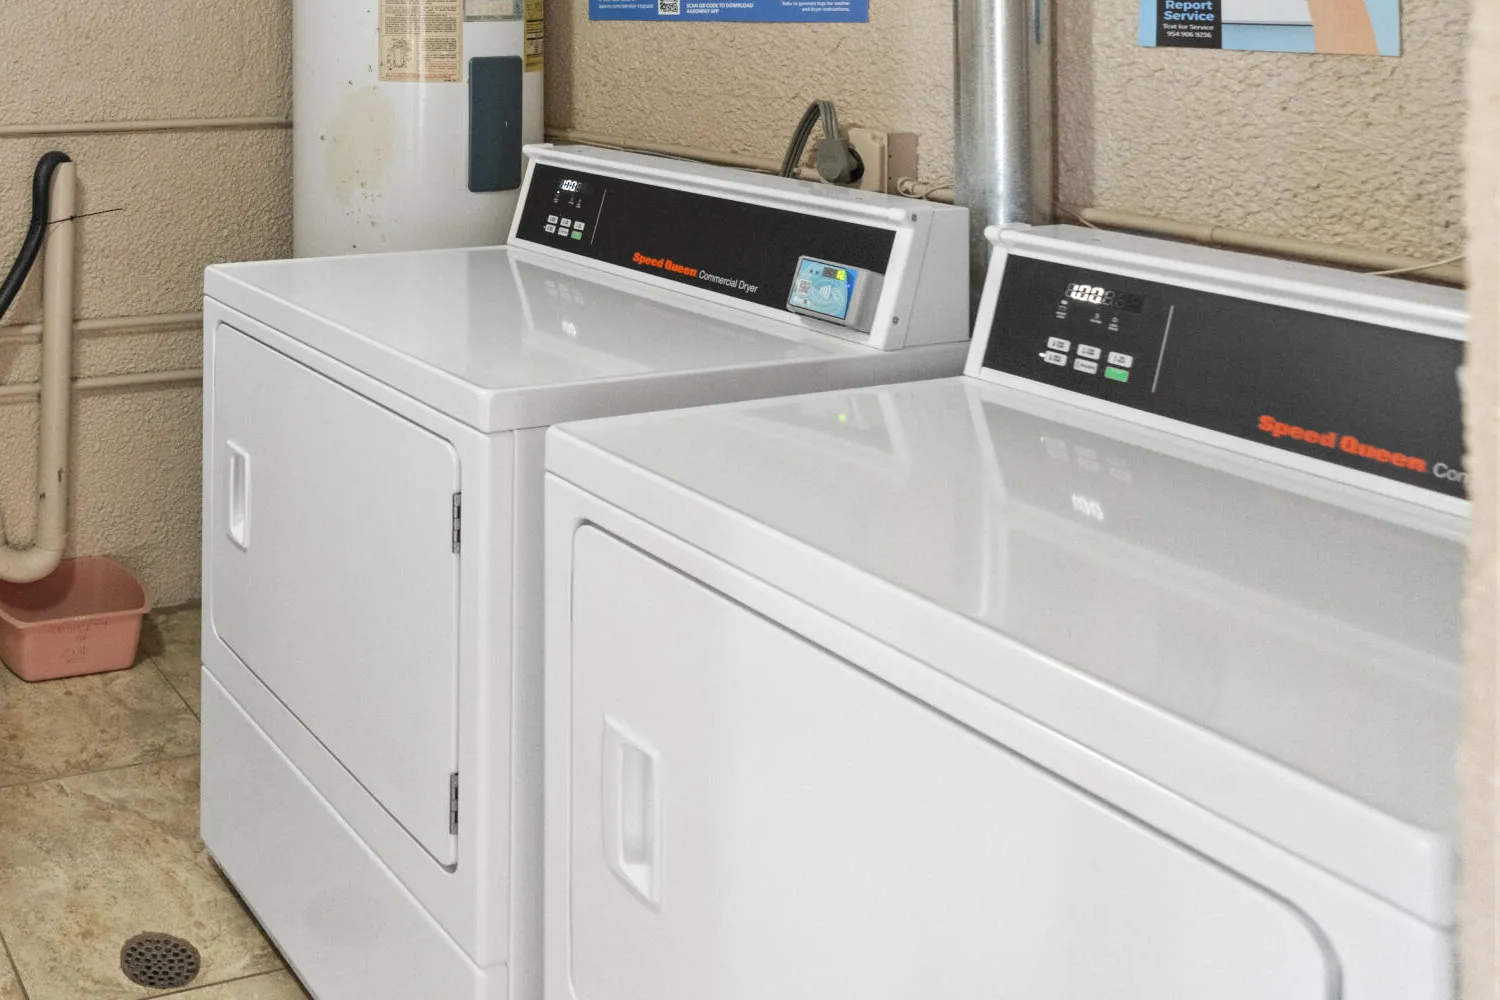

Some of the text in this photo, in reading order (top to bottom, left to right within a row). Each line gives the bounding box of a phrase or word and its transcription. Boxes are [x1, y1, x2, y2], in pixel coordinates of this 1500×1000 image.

[1164, 11, 1214, 21] Service
[1165, 0, 1213, 12] Report
[633, 252, 758, 293] Speed Queen Commercial Dryer
[1258, 415, 1337, 449] Speed
[1339, 435, 1427, 473] Queen
